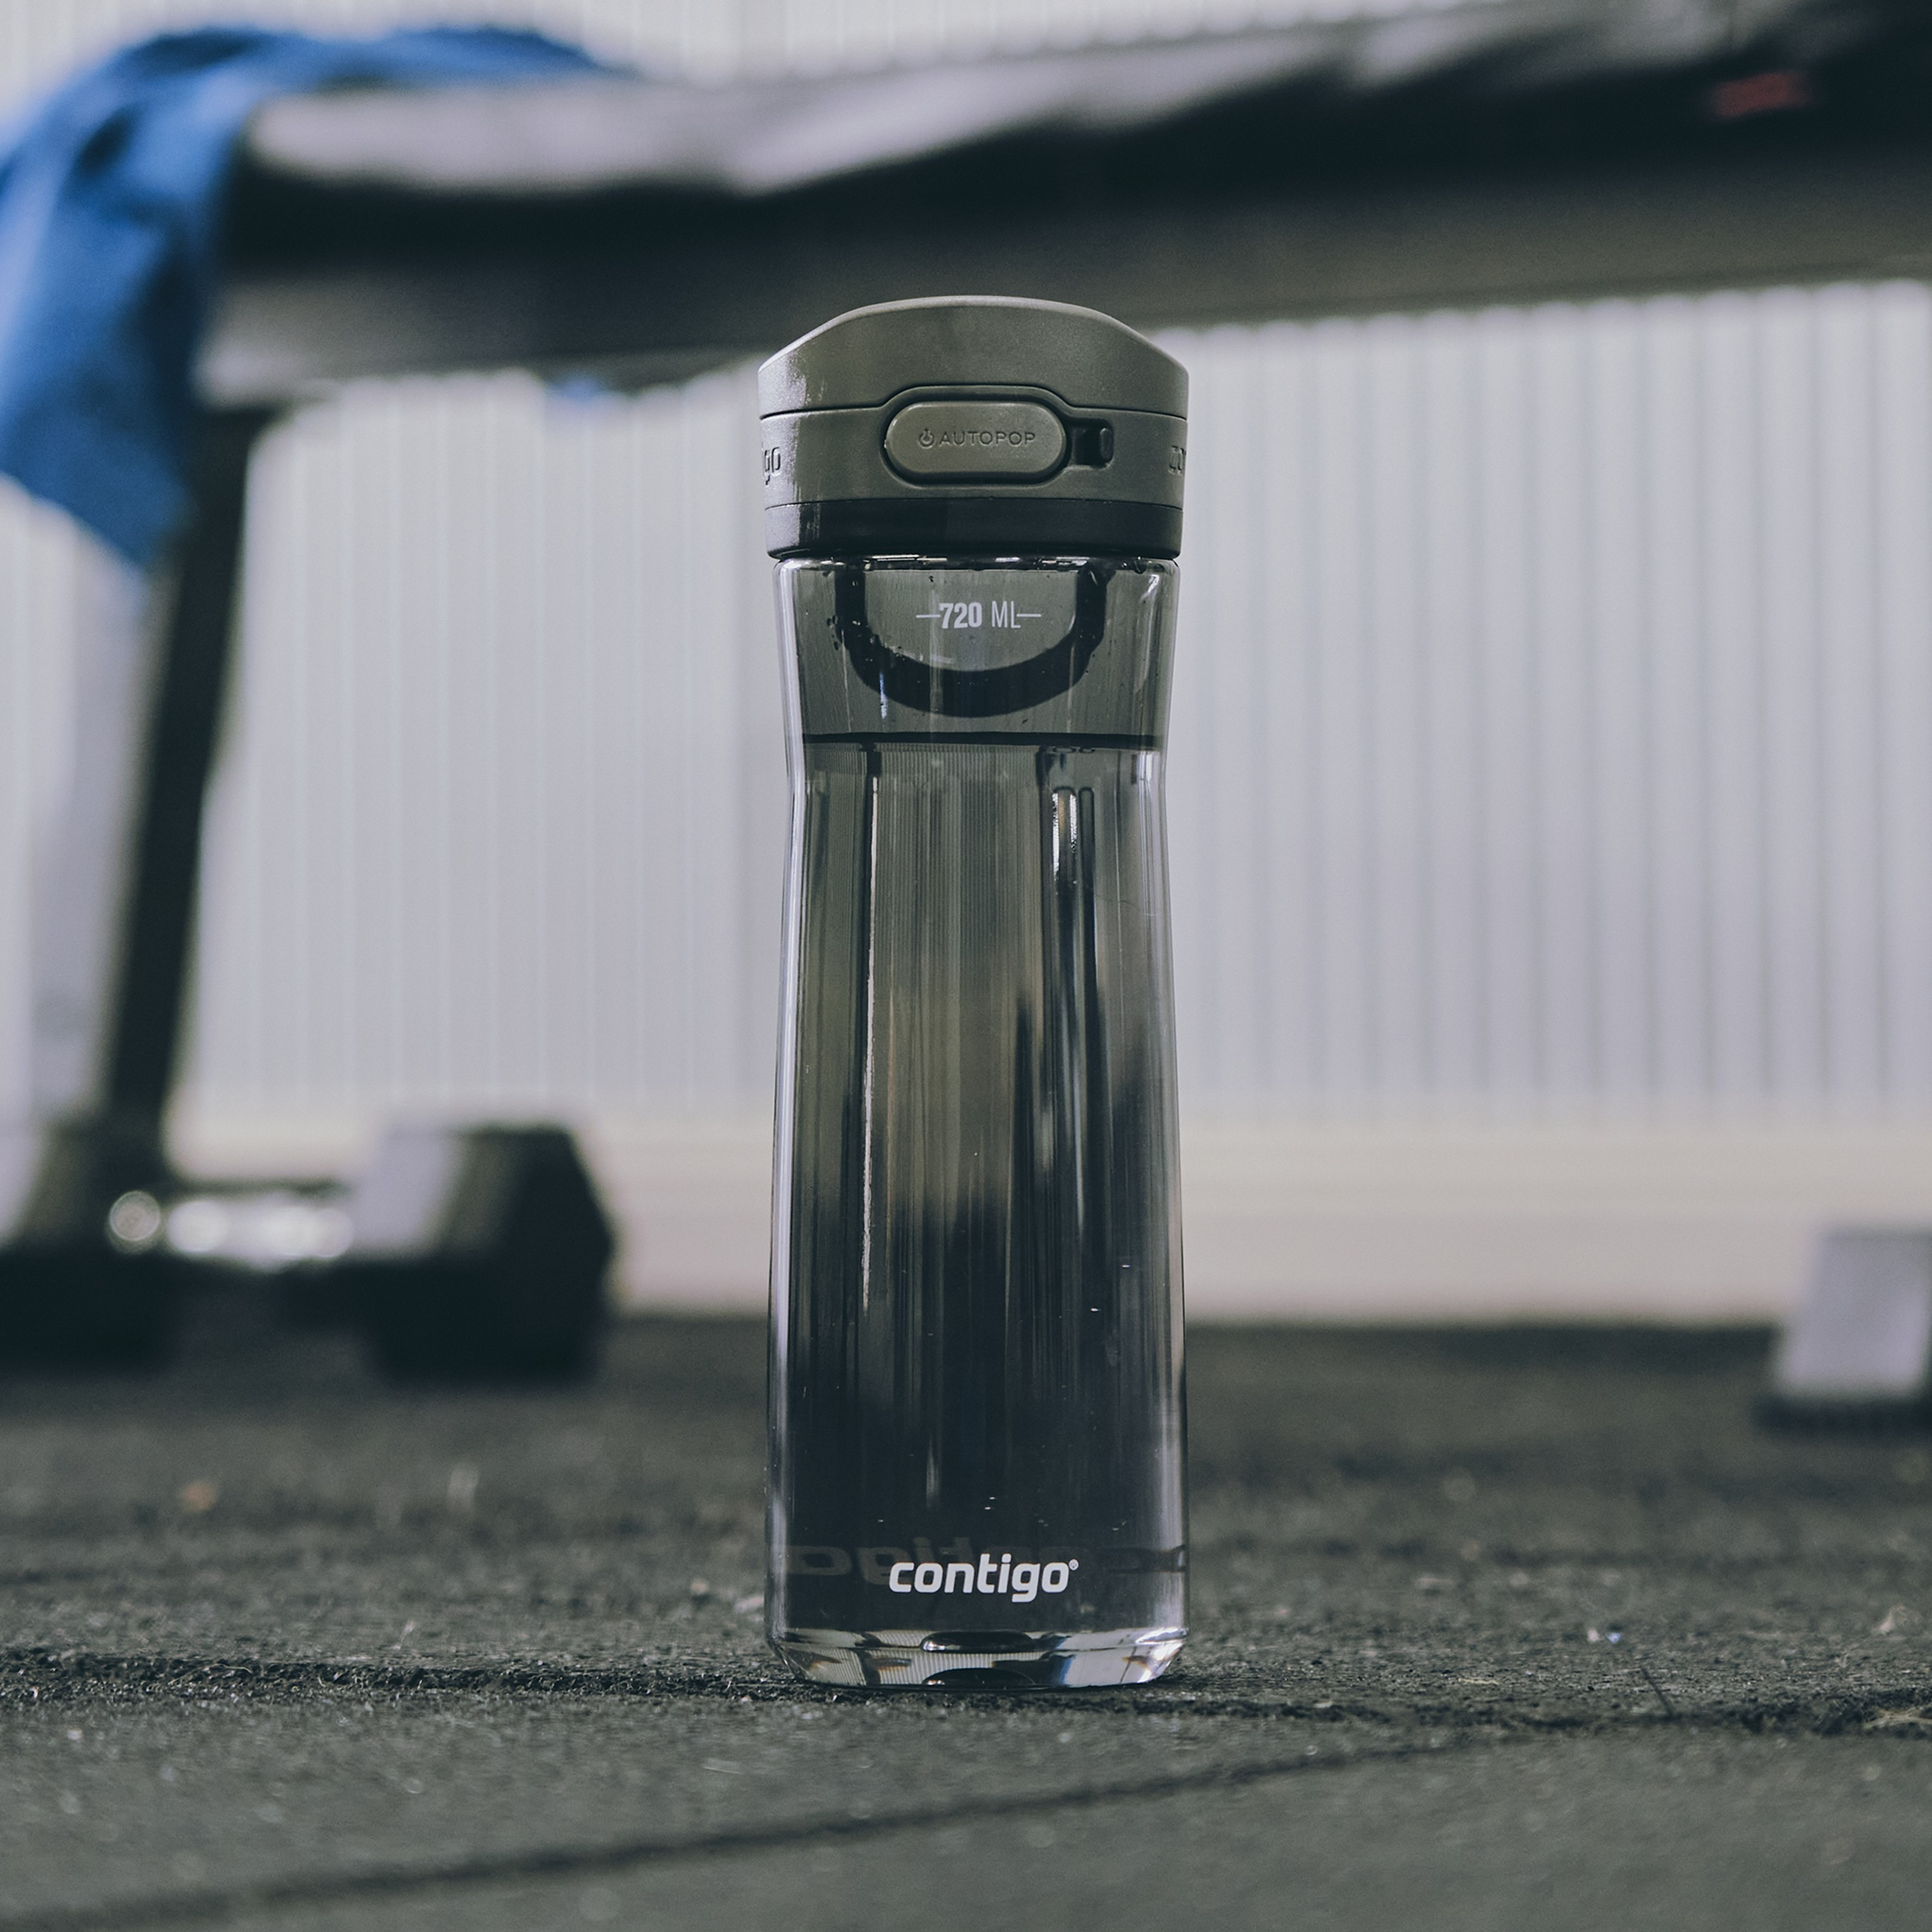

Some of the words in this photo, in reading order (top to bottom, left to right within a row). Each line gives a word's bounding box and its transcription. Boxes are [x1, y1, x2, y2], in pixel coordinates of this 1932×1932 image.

[938, 431, 1036, 446] AUTOPOP
[938, 601, 983, 629] 720
[991, 600, 1021, 629] ML
